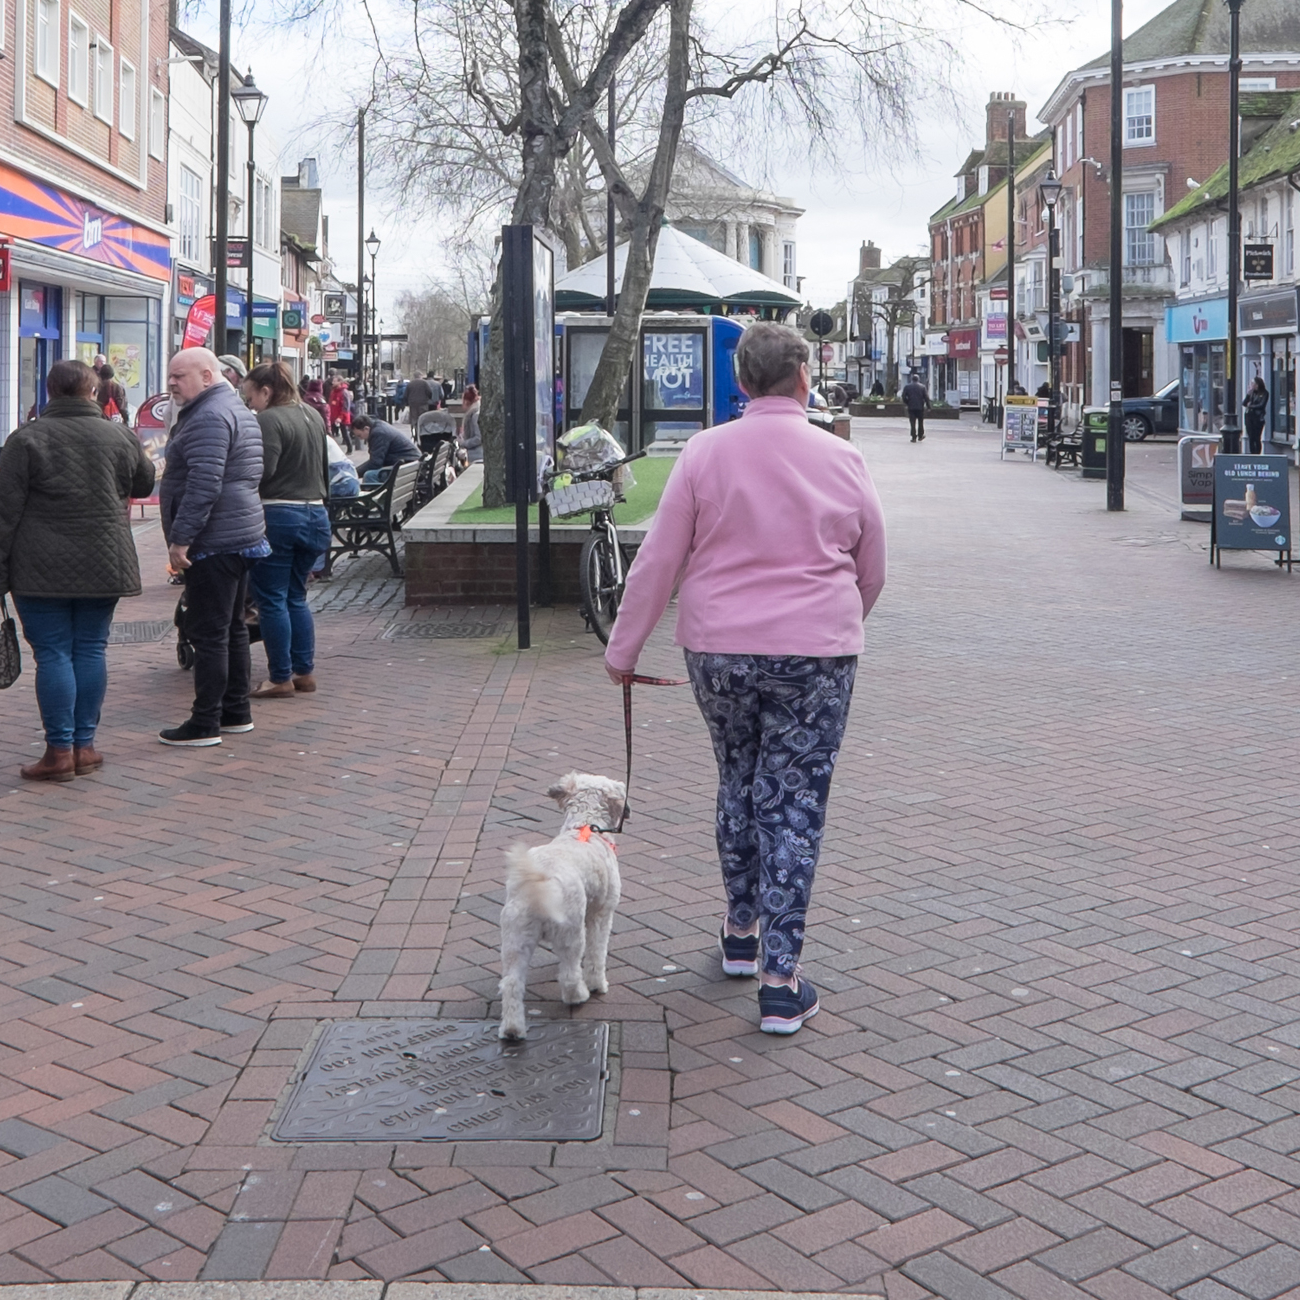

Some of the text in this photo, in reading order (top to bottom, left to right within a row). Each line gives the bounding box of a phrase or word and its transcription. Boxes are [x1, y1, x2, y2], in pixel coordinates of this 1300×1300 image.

[644, 335, 693, 353] FREE
[644, 354, 693, 368] HEALTH
[1188, 470, 1212, 480] Simp
[1190, 479, 1212, 488] Vap
[361, 1023, 459, 1059] CHIEFTAIN
[400, 1054, 486, 1088] DUCTILE
[419, 1062, 506, 1097] DUCTILE
[380, 1090, 472, 1127] STANTON
[486, 1053, 575, 1089] STAVELEY
[447, 1090, 550, 1134] CHIEFTAIN
